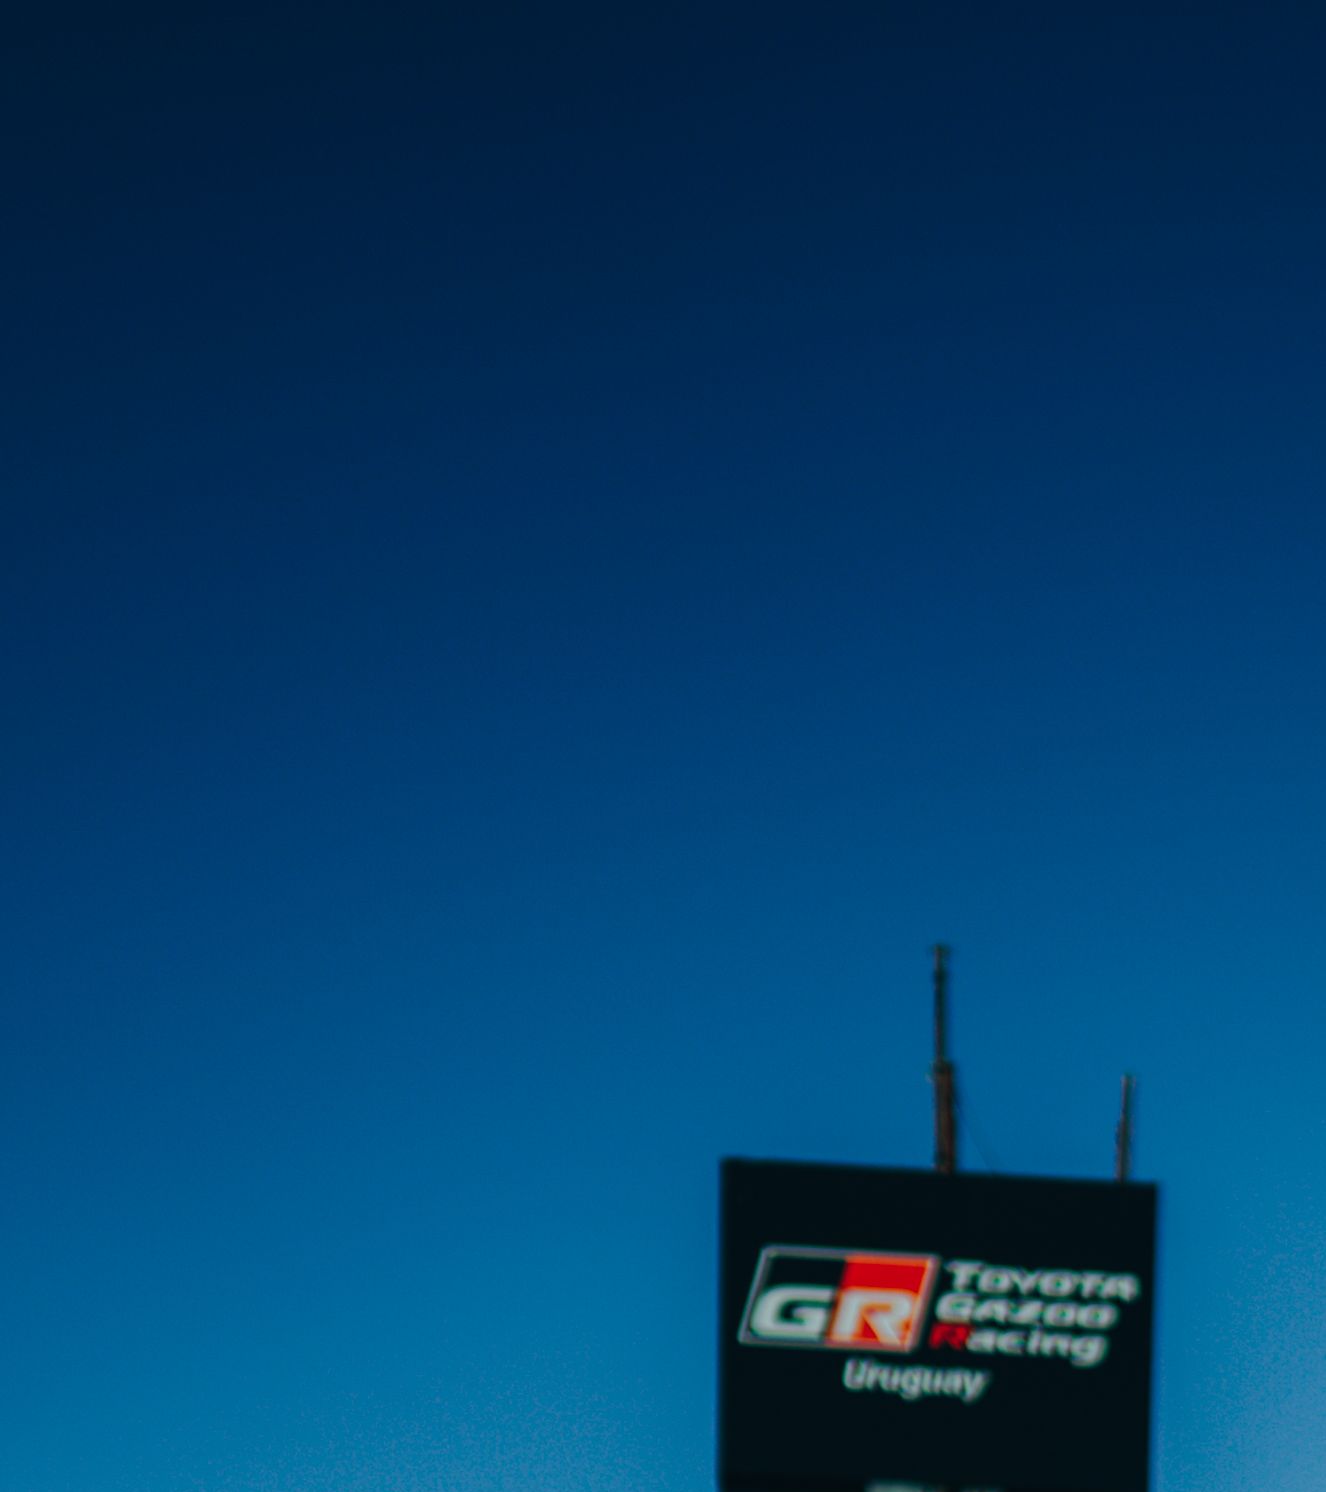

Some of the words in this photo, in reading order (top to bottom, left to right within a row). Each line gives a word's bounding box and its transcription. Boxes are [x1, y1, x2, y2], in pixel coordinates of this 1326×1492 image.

[946, 1259, 1140, 1302] TOYOTA
[750, 1285, 914, 1346] GR
[935, 1291, 1119, 1330] GAZOO
[929, 1321, 1109, 1369] Racing
[843, 1357, 990, 1403] Uruguay
